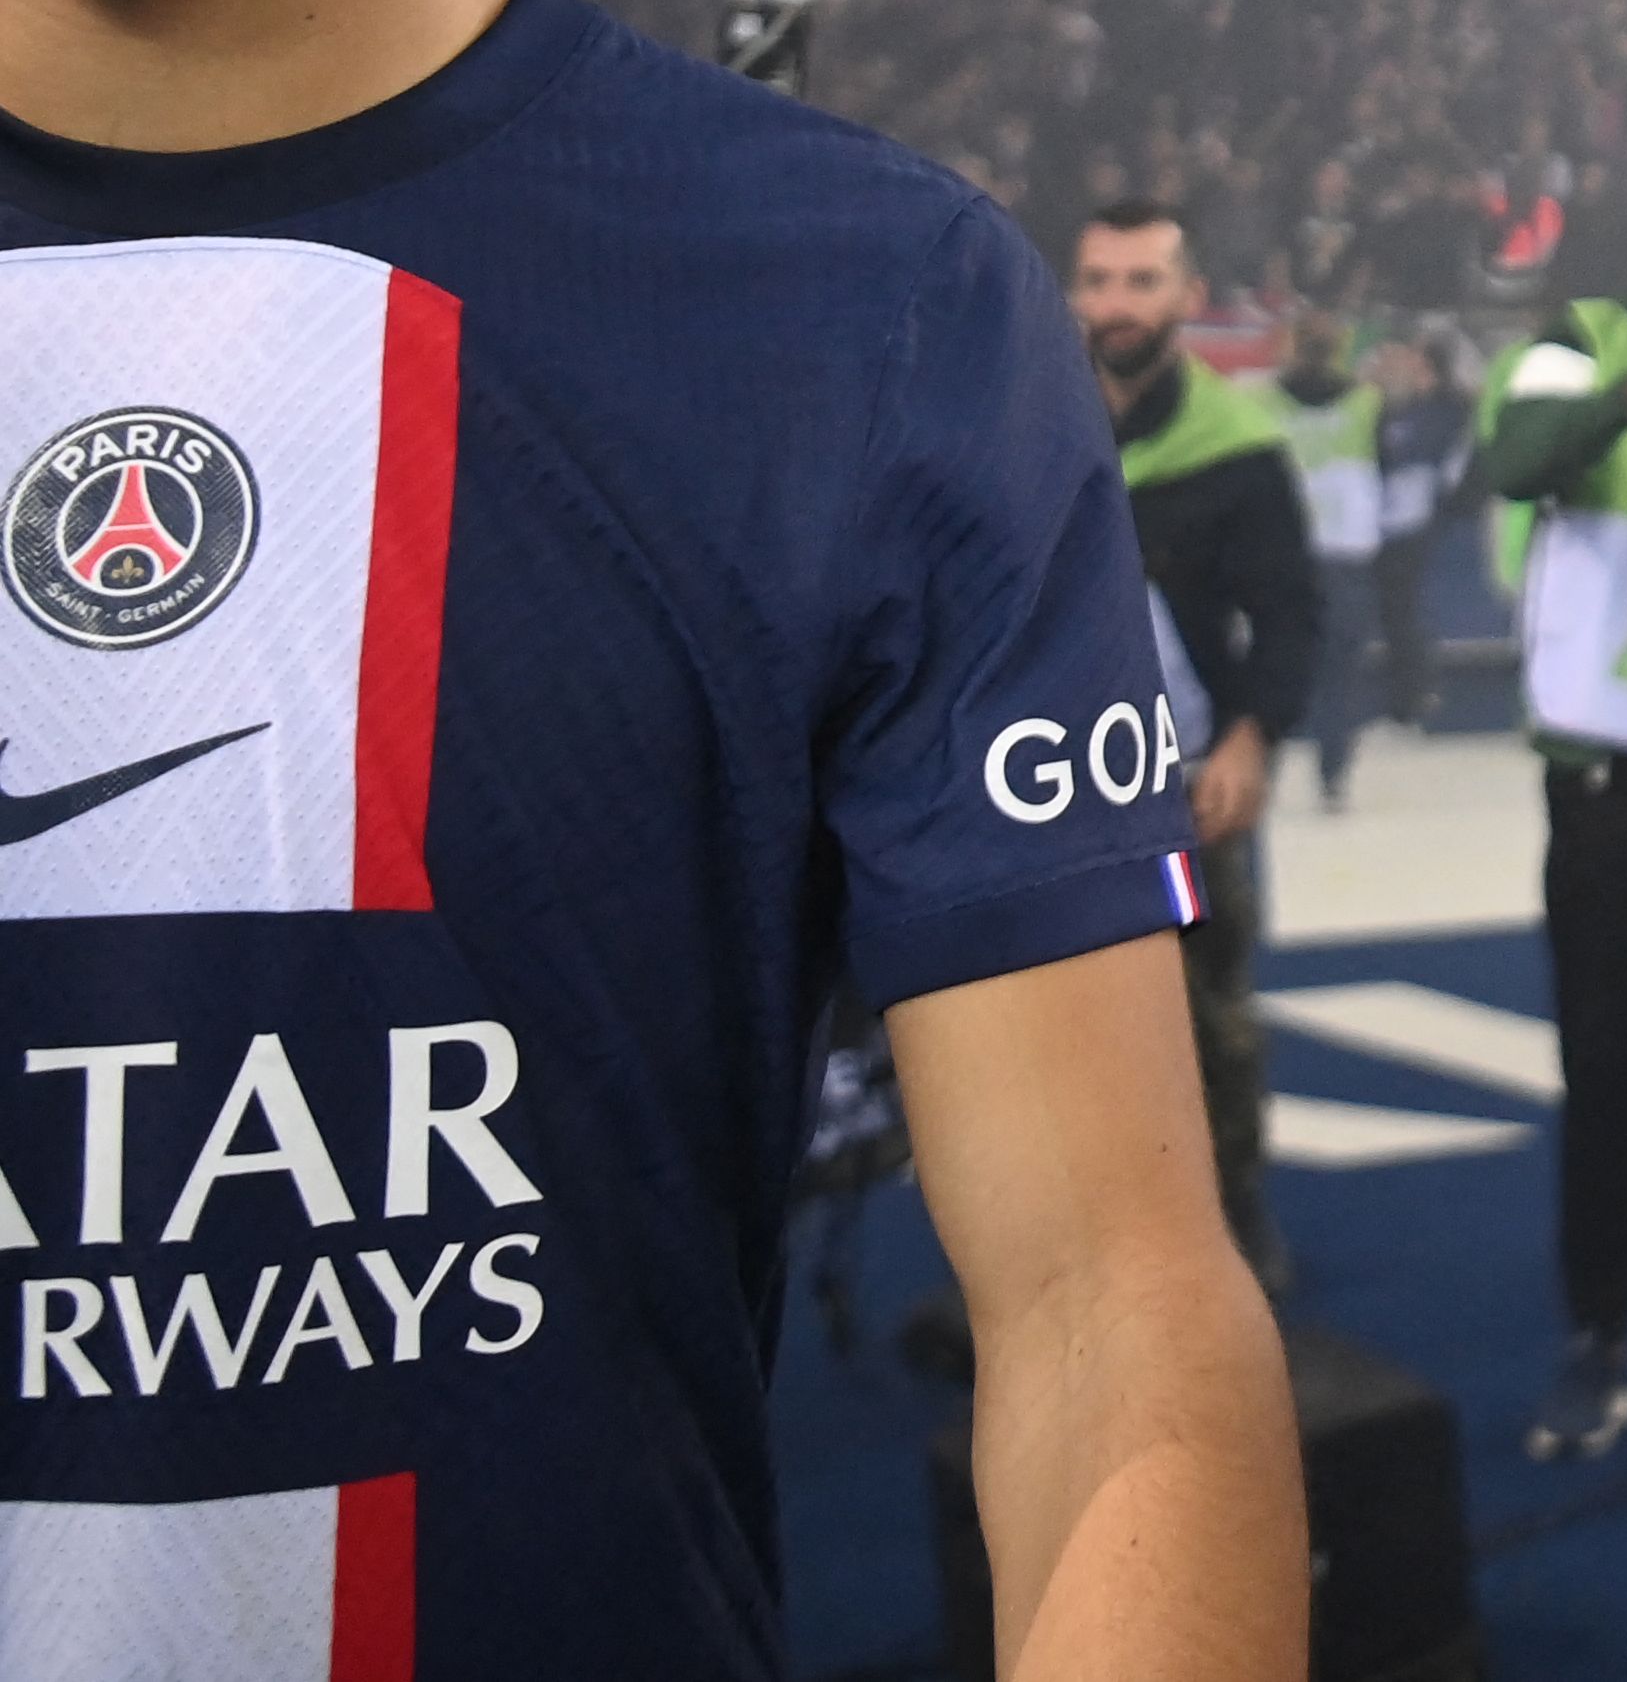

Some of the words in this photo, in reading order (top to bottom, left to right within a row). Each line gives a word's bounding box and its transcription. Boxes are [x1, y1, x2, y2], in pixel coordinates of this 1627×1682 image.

[52, 423, 213, 482] PARIS
[47, 580, 104, 620] SAINT
[117, 573, 206, 624] GERMAIN
[984, 693, 1182, 824] GOA
[19, 1232, 545, 1400] RWAYS
